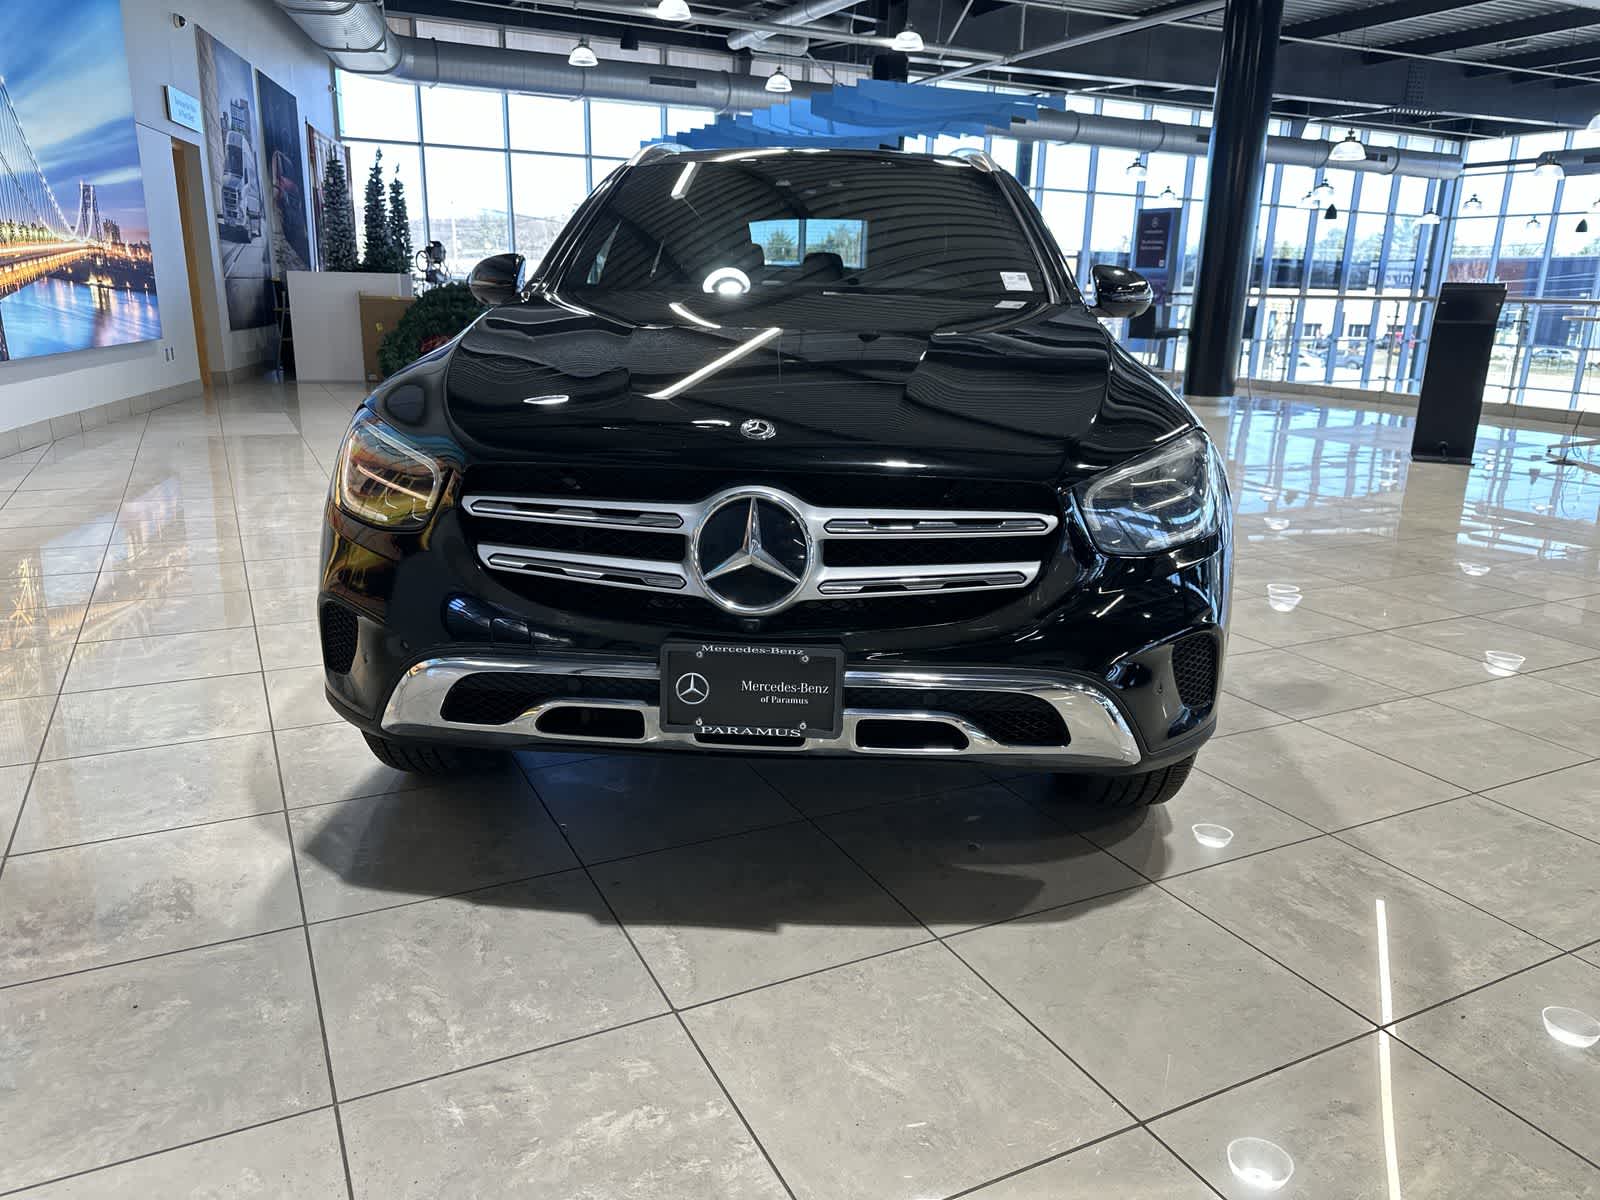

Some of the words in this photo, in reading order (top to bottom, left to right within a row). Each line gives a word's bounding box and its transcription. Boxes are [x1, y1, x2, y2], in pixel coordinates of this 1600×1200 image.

[701, 644, 804, 656] Mercedes-Benz
[741, 680, 829, 694] Mercedes-Benz
[771, 696, 809, 705] Paramus
[700, 726, 801, 737] PARAMUS
